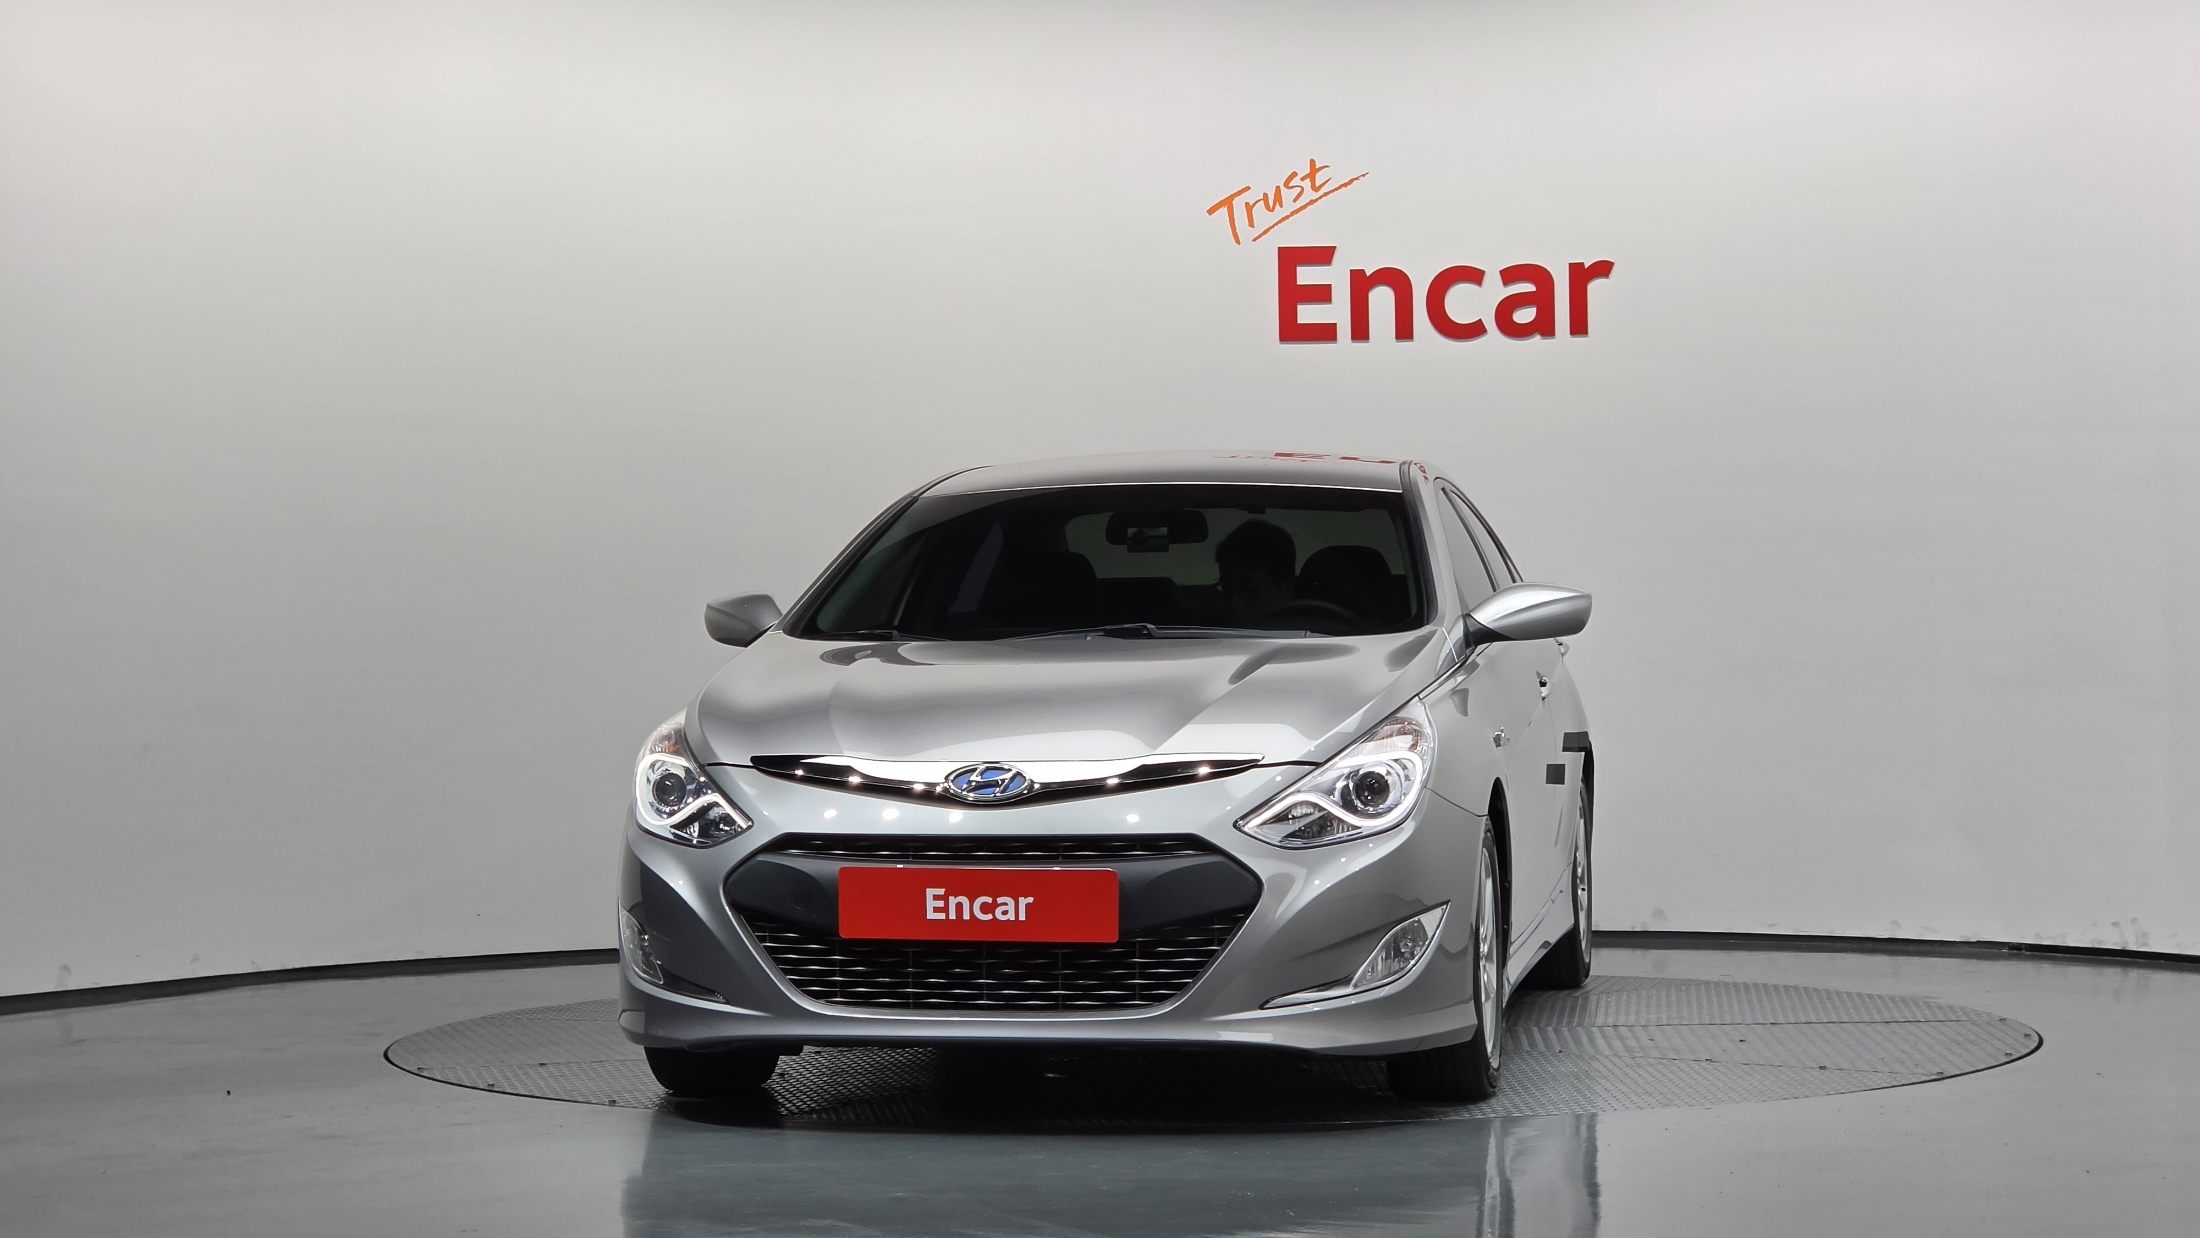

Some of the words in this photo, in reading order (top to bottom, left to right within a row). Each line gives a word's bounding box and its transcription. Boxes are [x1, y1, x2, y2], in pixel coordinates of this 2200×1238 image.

[1206, 158, 1331, 246] Trust
[1277, 246, 1615, 344] Encar
[924, 887, 1035, 922] Encar
